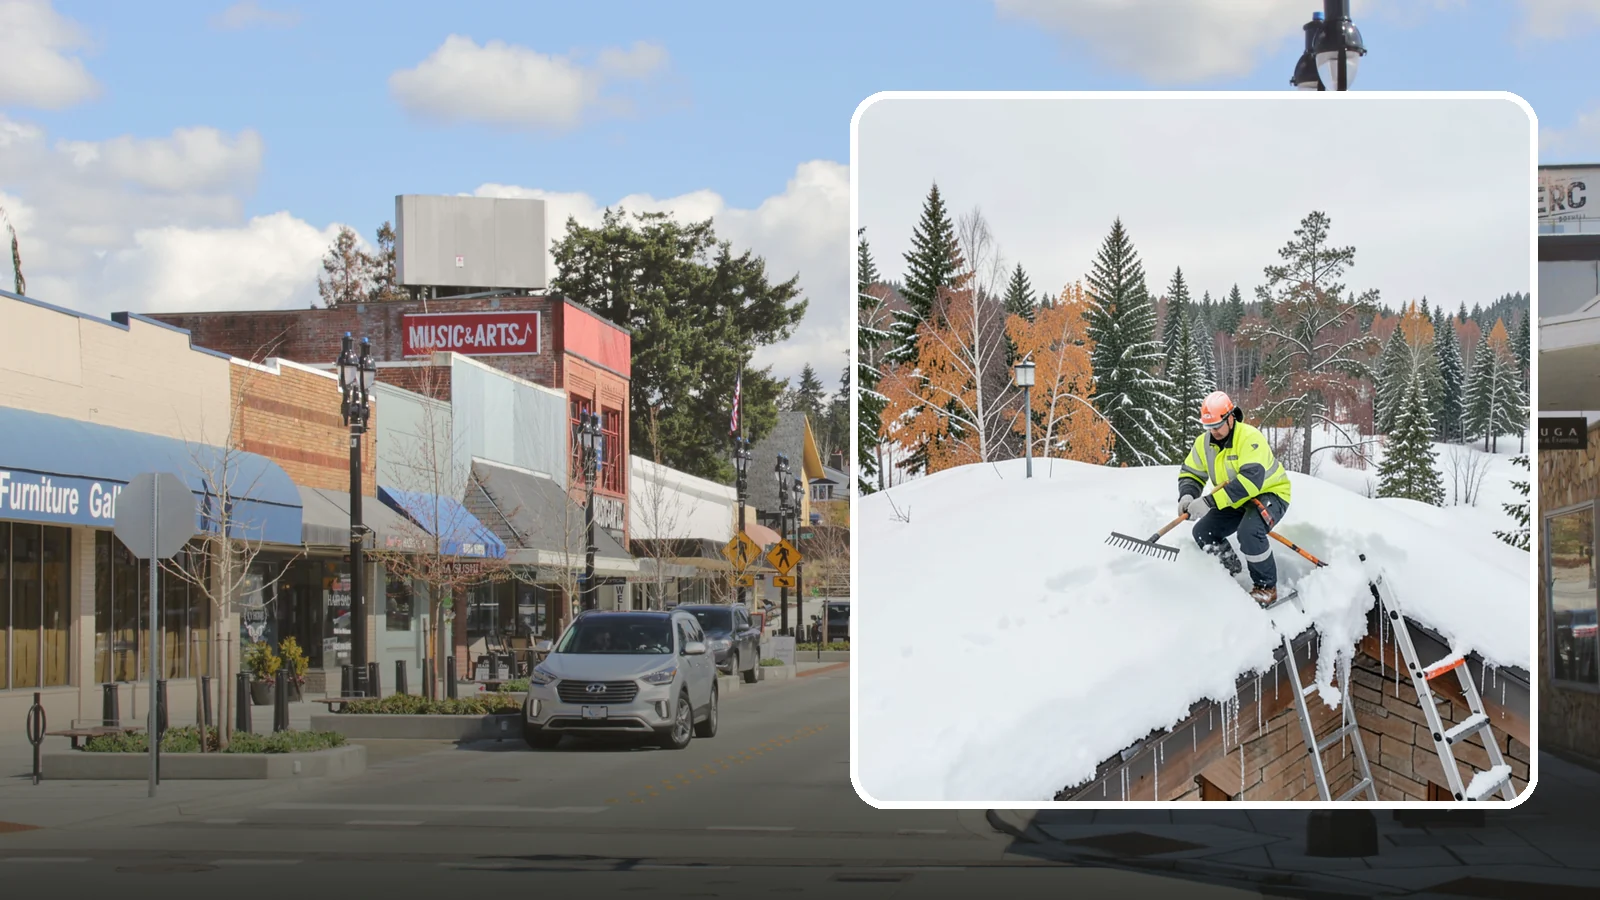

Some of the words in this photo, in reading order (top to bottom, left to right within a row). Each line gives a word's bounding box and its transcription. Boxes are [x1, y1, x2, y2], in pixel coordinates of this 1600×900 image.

[409, 323, 520, 349] MUSIC&ARTS
[0, 471, 80, 516] Furniture
[89, 482, 122, 519] Gal
